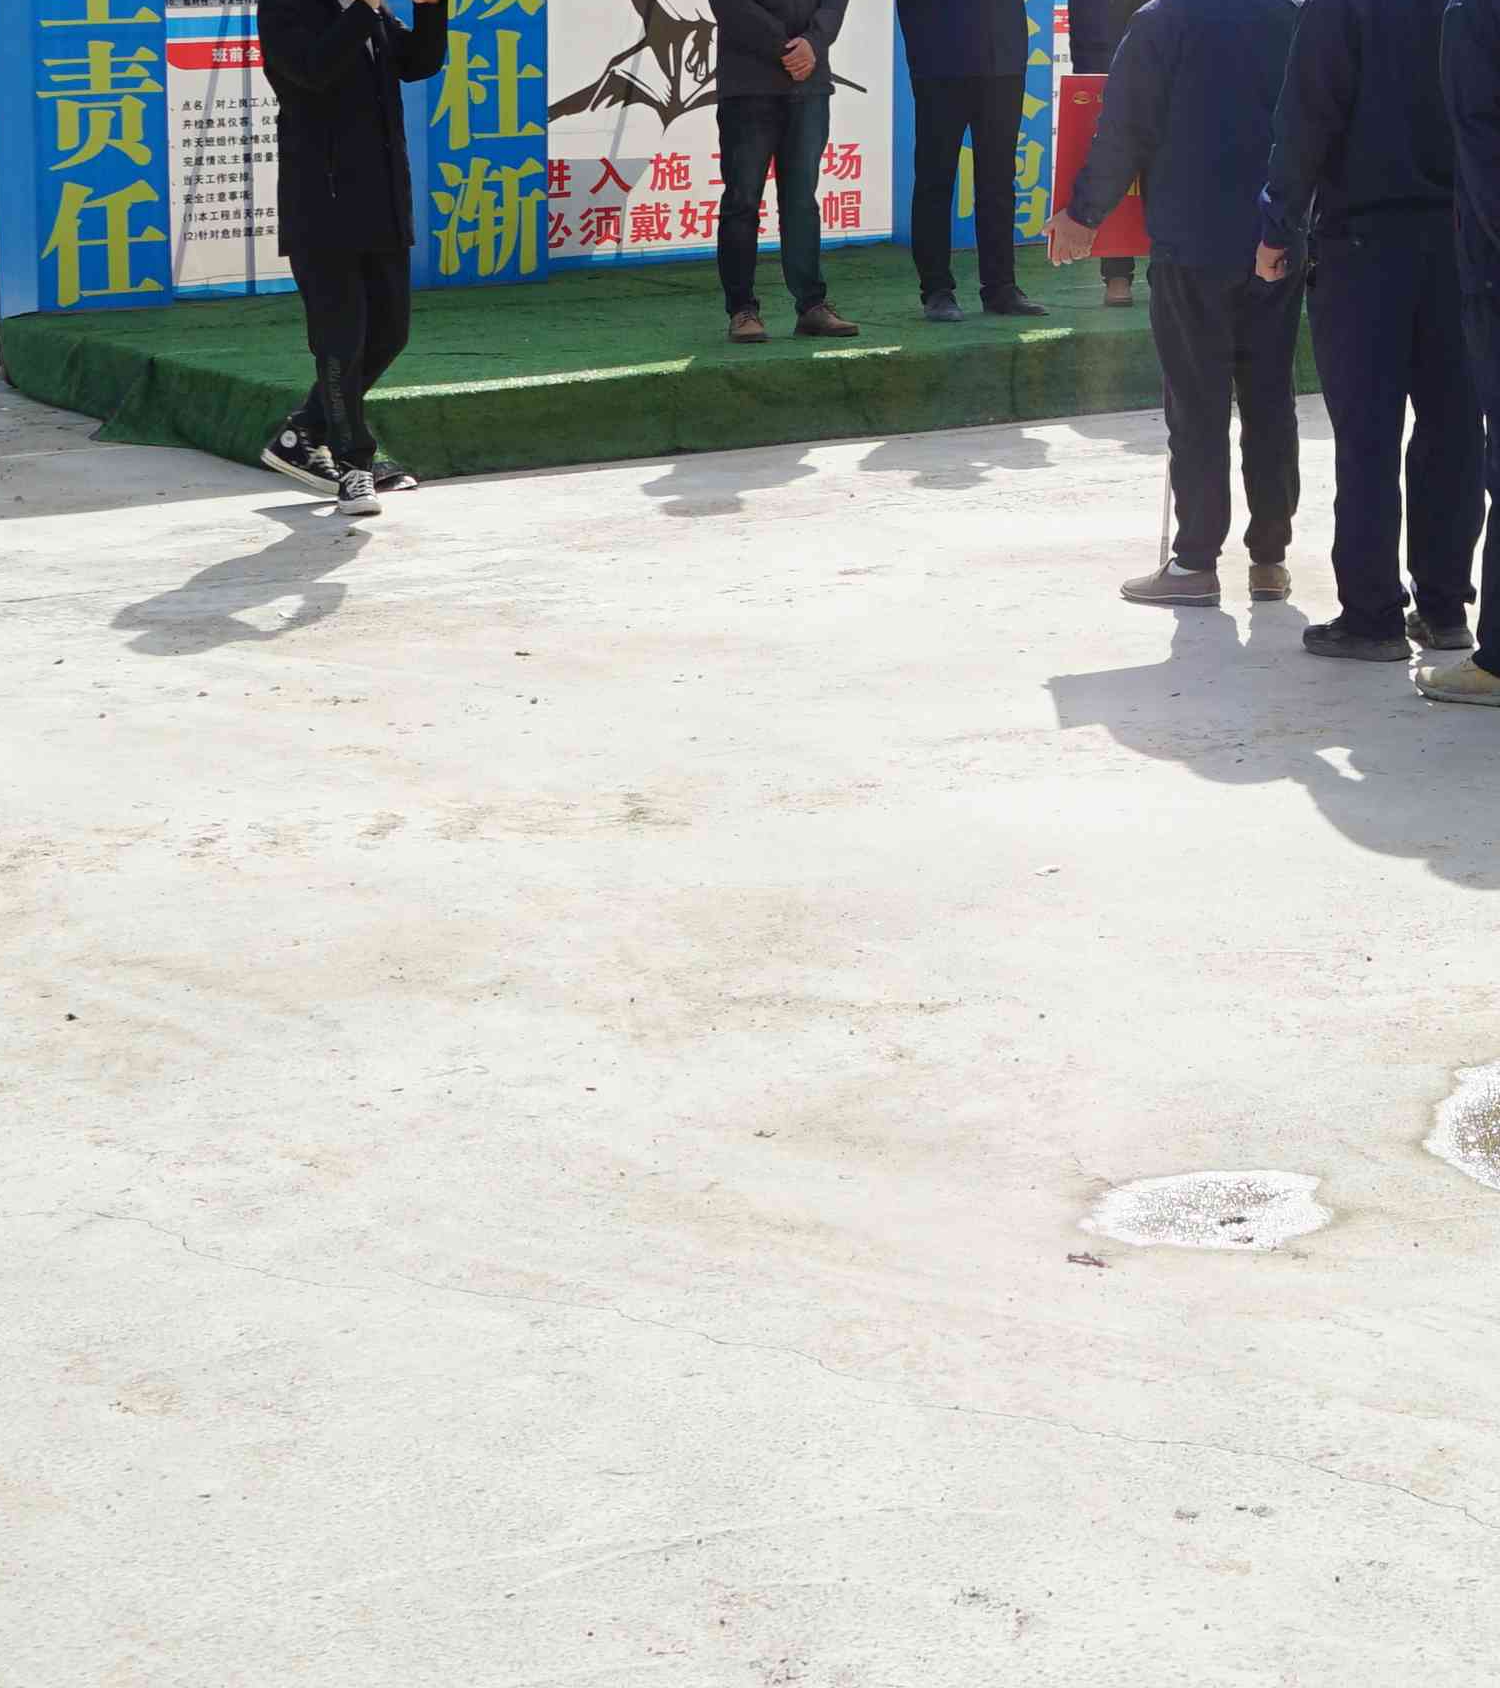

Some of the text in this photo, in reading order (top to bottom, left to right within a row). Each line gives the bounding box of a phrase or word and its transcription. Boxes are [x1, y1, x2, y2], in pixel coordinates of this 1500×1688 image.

[211, 47, 261, 63] 班前会
[548, 142, 862, 199] 进入施场
[548, 190, 862, 248] 必须戴好帽
